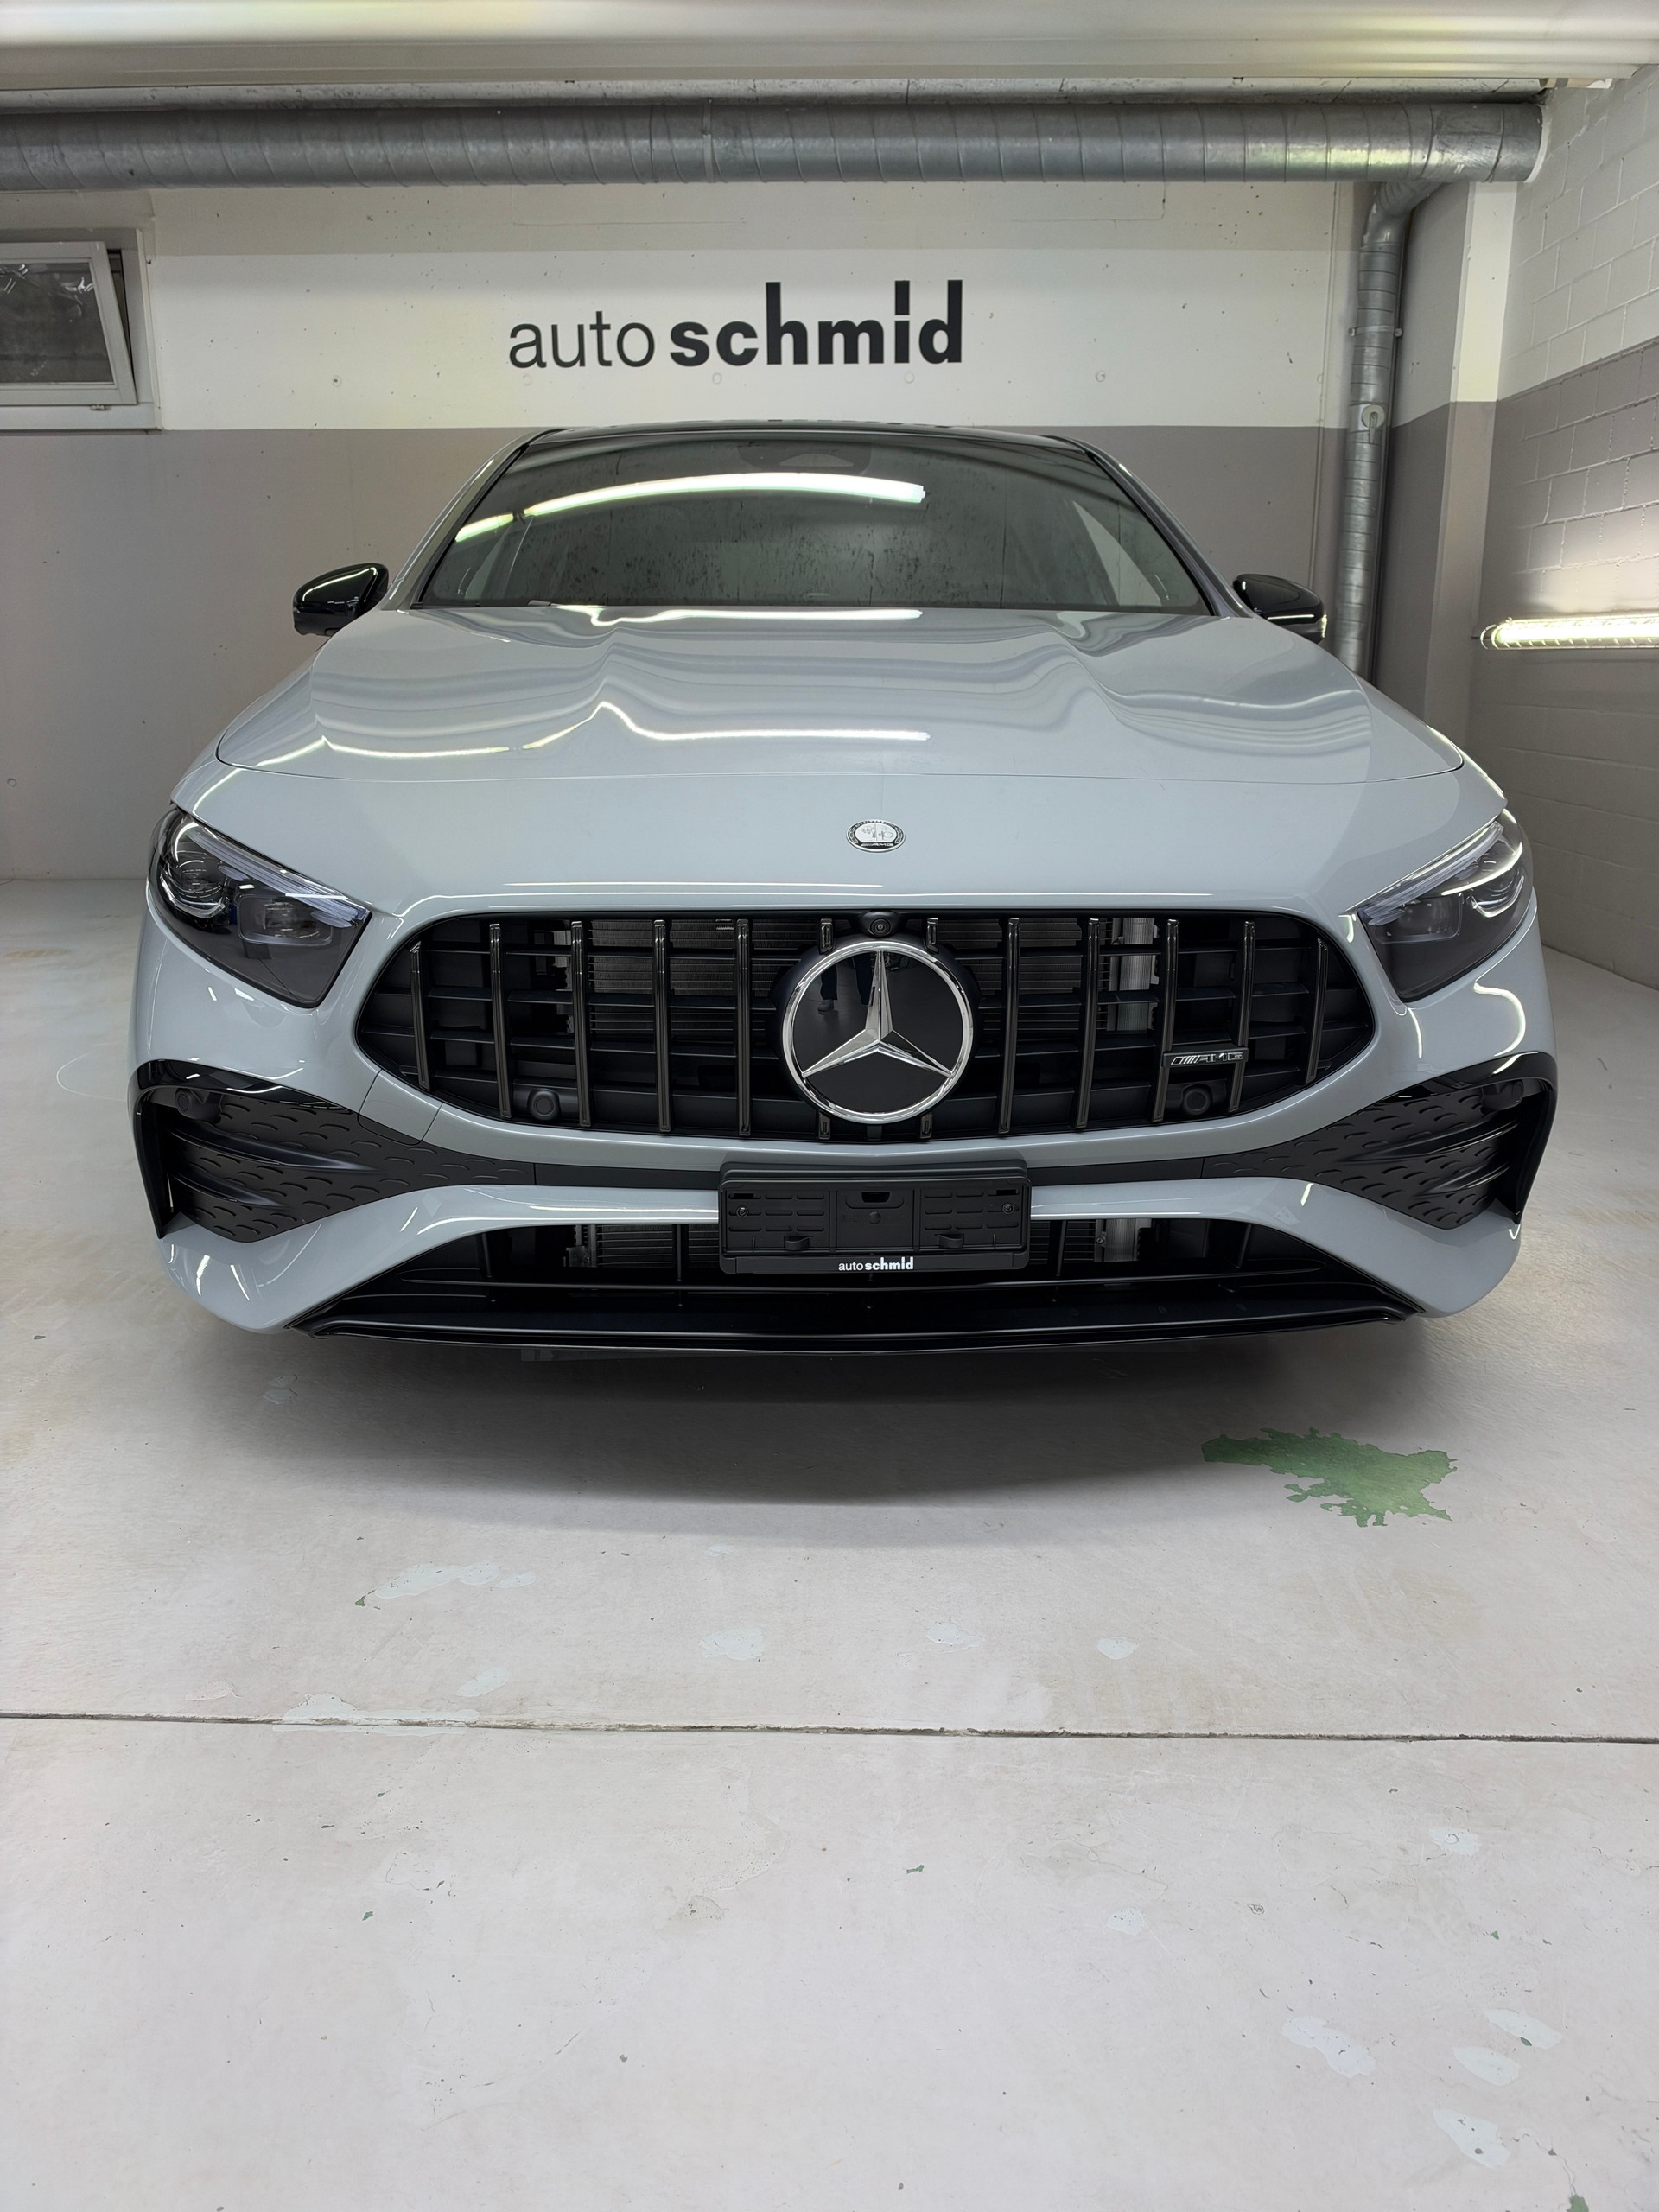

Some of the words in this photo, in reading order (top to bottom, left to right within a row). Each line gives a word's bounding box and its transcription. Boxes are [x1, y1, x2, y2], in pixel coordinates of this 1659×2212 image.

[508, 311, 656, 369] auto
[669, 279, 963, 367] schmid
[838, 1261, 864, 1271] auto
[864, 1256, 914, 1270] schmid
